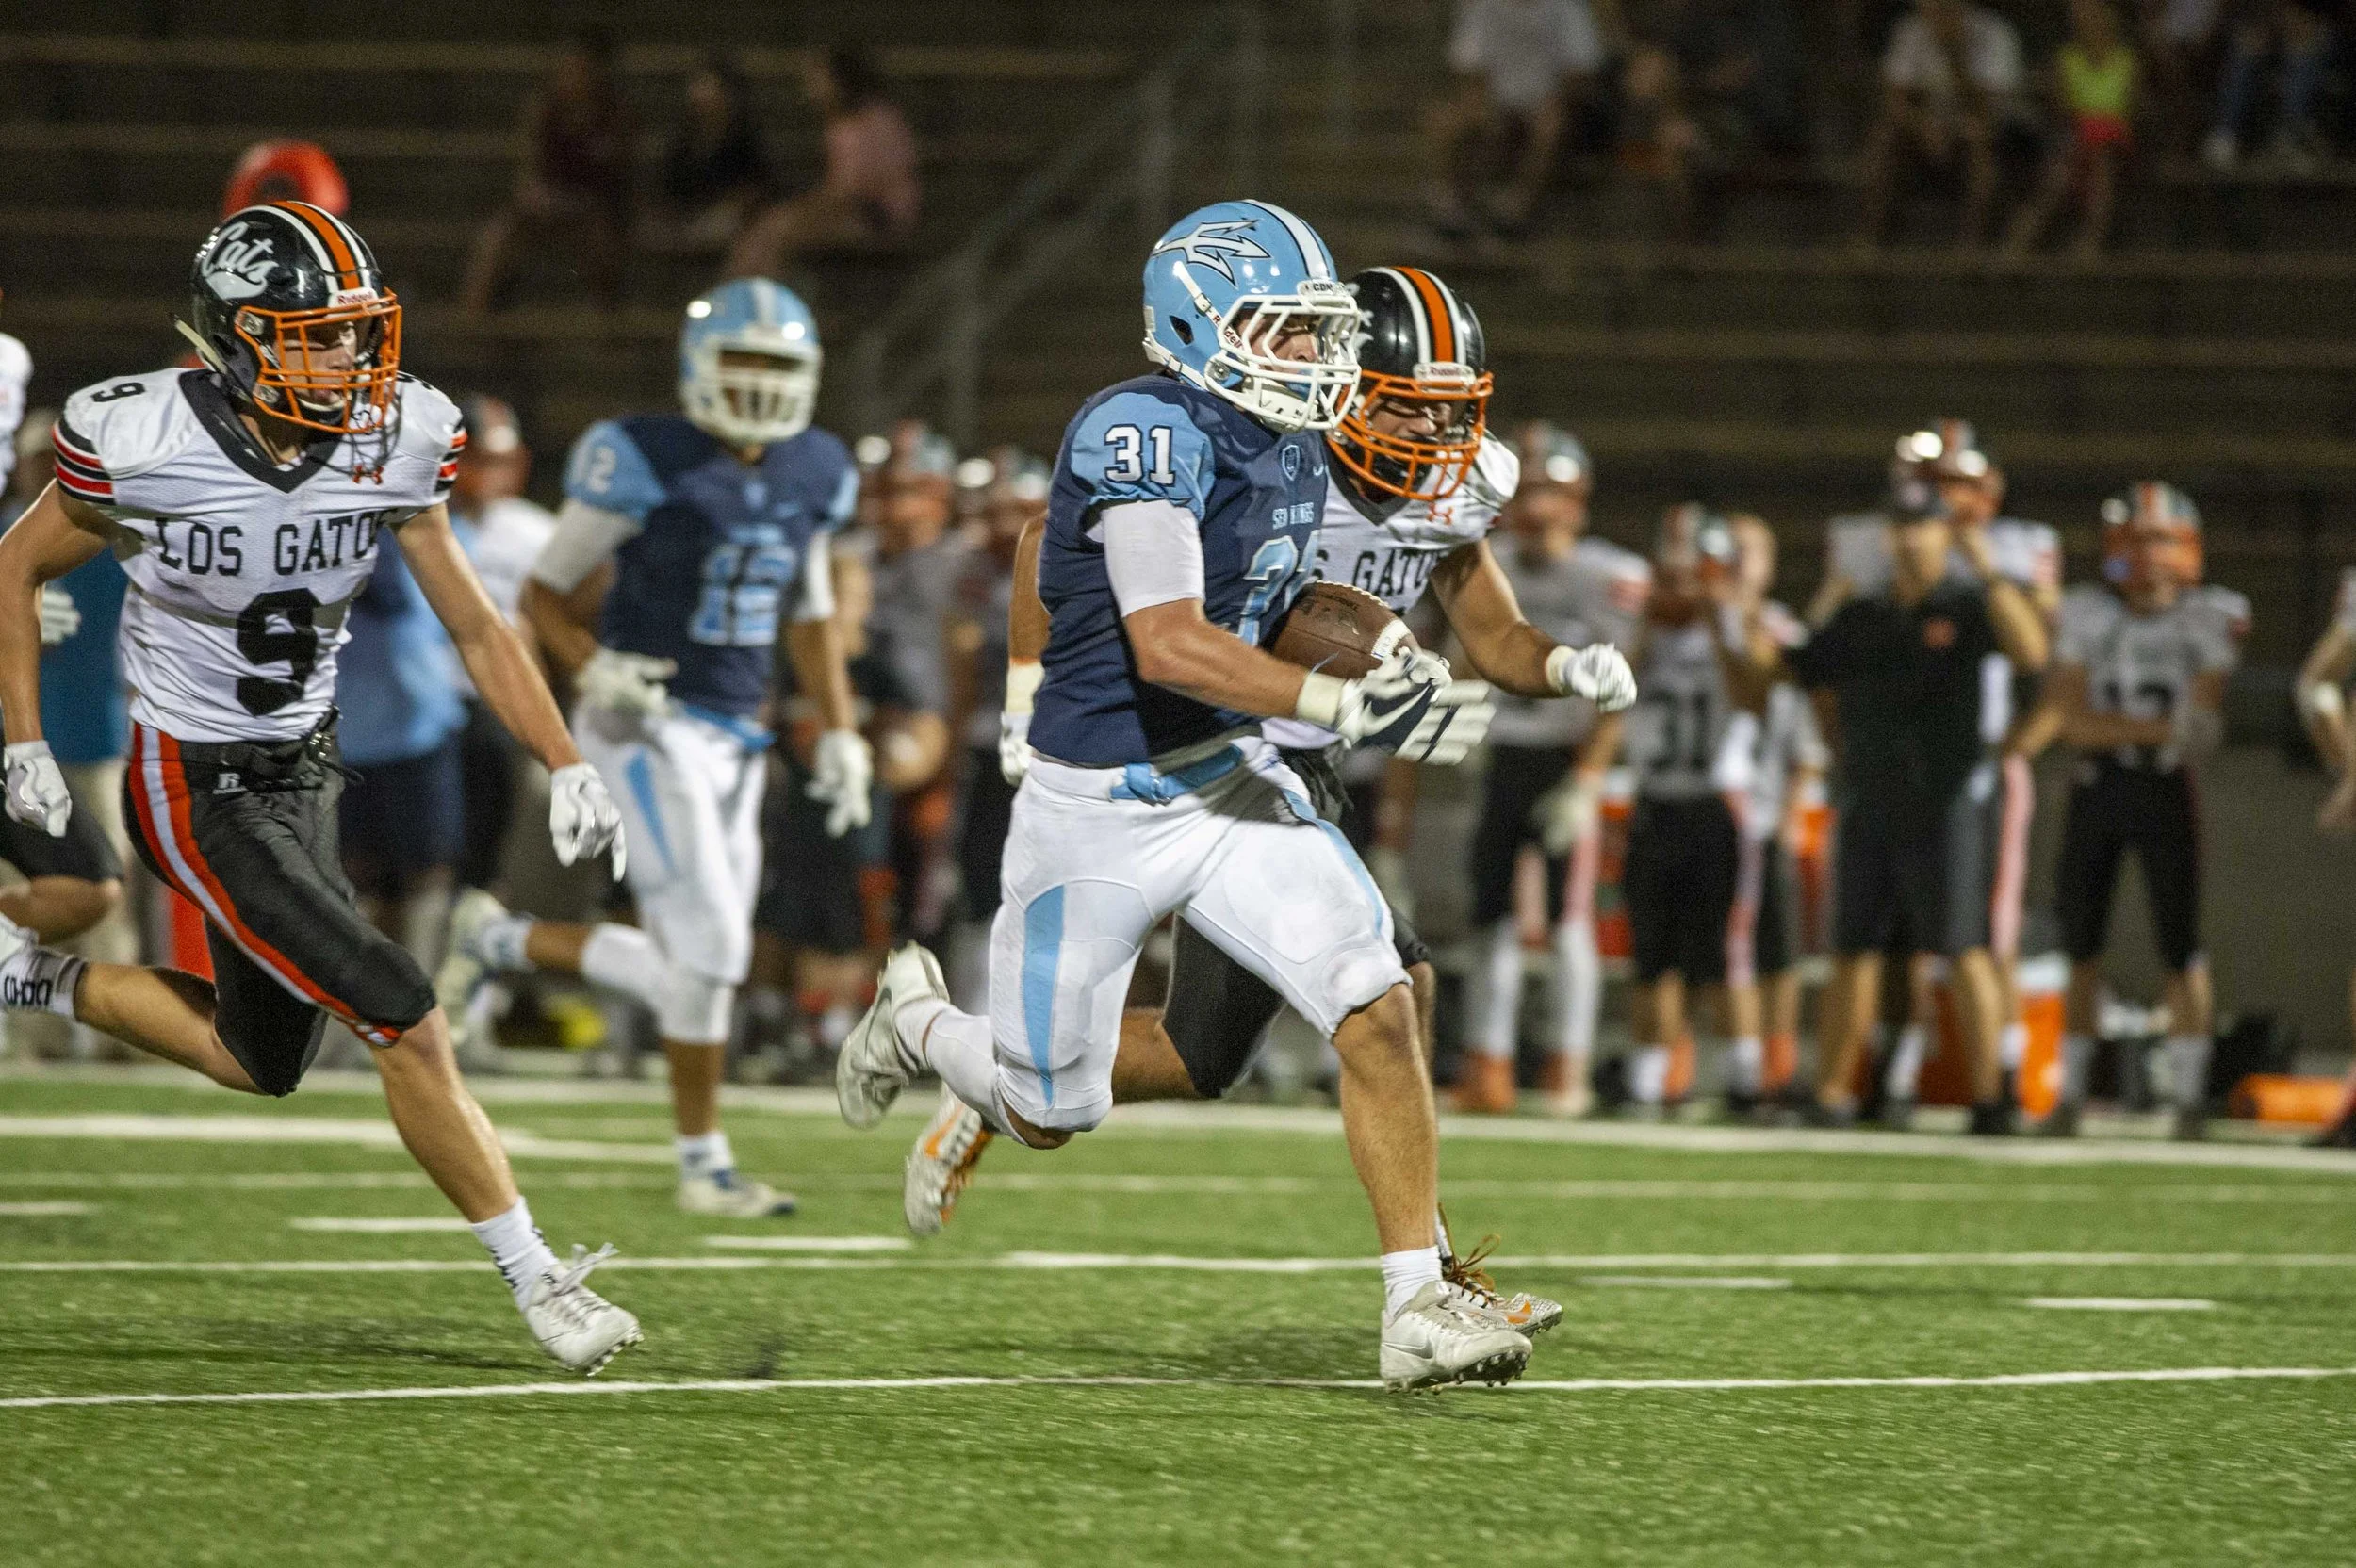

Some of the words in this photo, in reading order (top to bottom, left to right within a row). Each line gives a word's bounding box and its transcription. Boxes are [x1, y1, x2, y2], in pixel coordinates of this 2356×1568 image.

[201, 221, 280, 286] Cats
[1213, 315, 1243, 348] Rdell
[90, 382, 146, 402] 9
[1104, 423, 1175, 487] 31
[156, 518, 243, 576] LOS
[237, 587, 322, 717] 9
